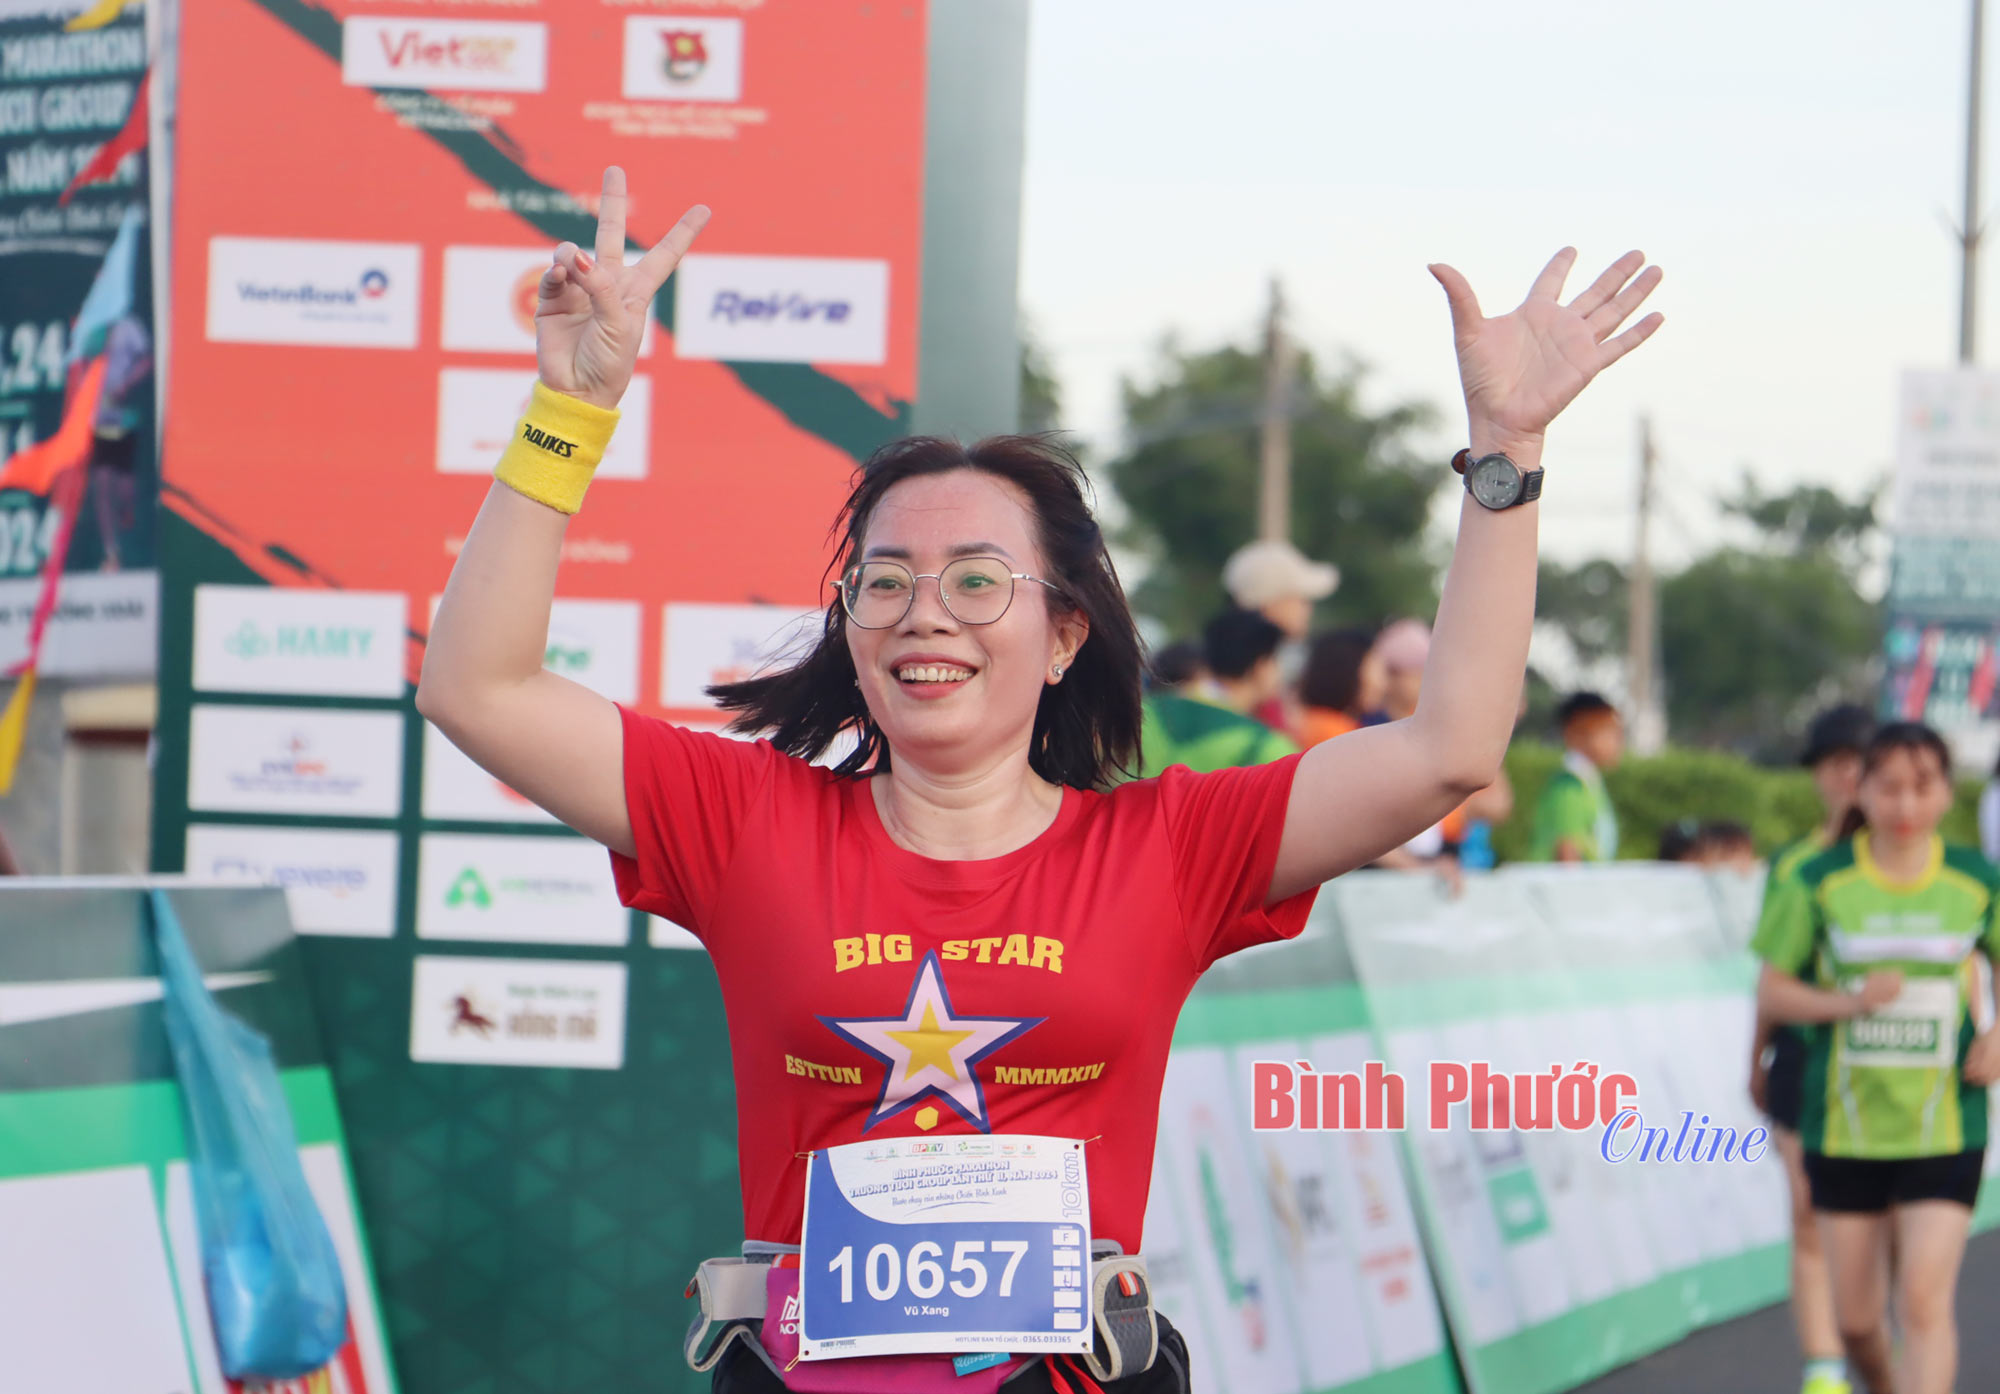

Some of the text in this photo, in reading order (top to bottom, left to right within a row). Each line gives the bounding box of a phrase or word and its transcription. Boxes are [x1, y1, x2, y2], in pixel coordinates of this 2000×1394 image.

[523, 423, 579, 458] AOLIKES
[277, 626, 373, 657] HAMY
[833, 933, 1064, 974] BIG STAR
[785, 1054, 862, 1084] ESTTUN
[995, 1062, 1105, 1085] MMMXIV
[1061, 1152, 1082, 1218] 10km
[1063, 1233, 1069, 1241] F
[829, 1239, 1029, 1303] 10657
[904, 1305, 949, 1317] Vũ Xang
[1023, 1335, 1072, 1343] 0365.033365
